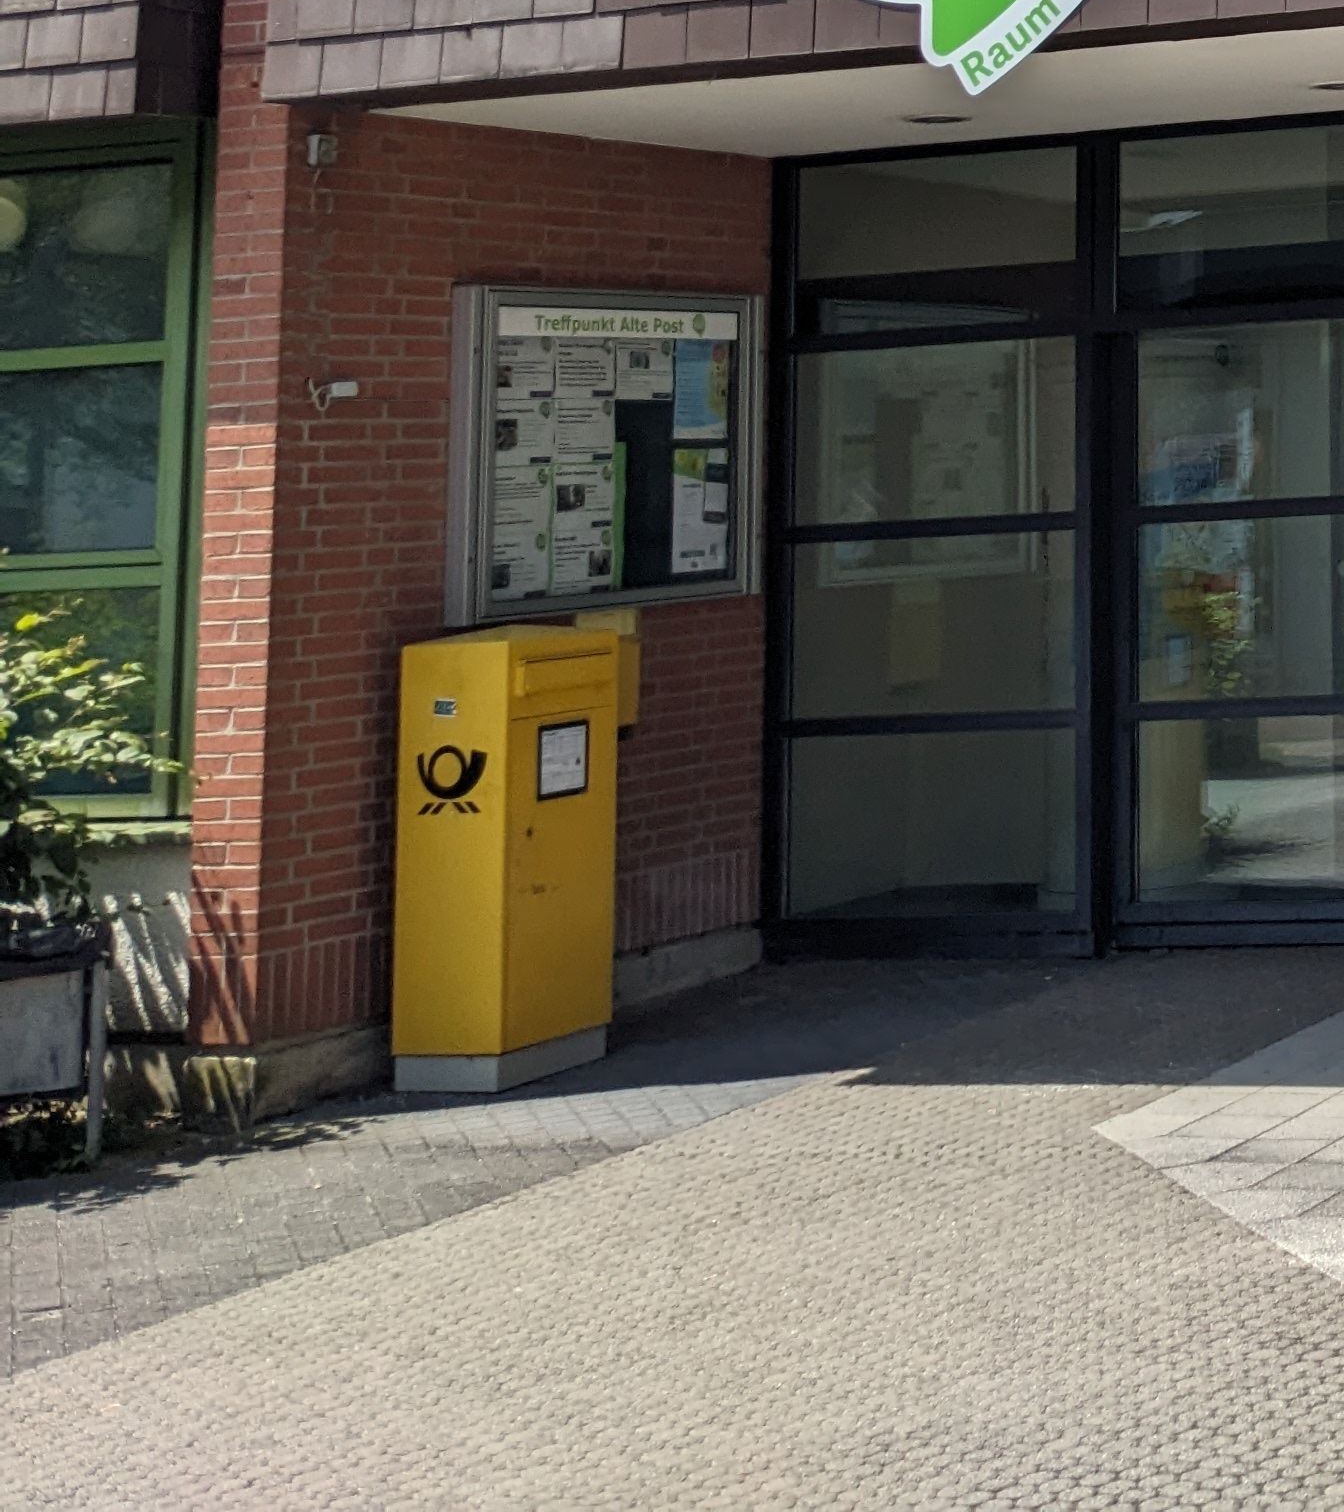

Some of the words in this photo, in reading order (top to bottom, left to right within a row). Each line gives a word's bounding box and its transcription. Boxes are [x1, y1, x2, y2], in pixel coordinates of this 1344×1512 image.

[534, 314, 616, 335] Treffpunkt
[620, 317, 649, 333] Alte
[652, 318, 685, 334] Post
